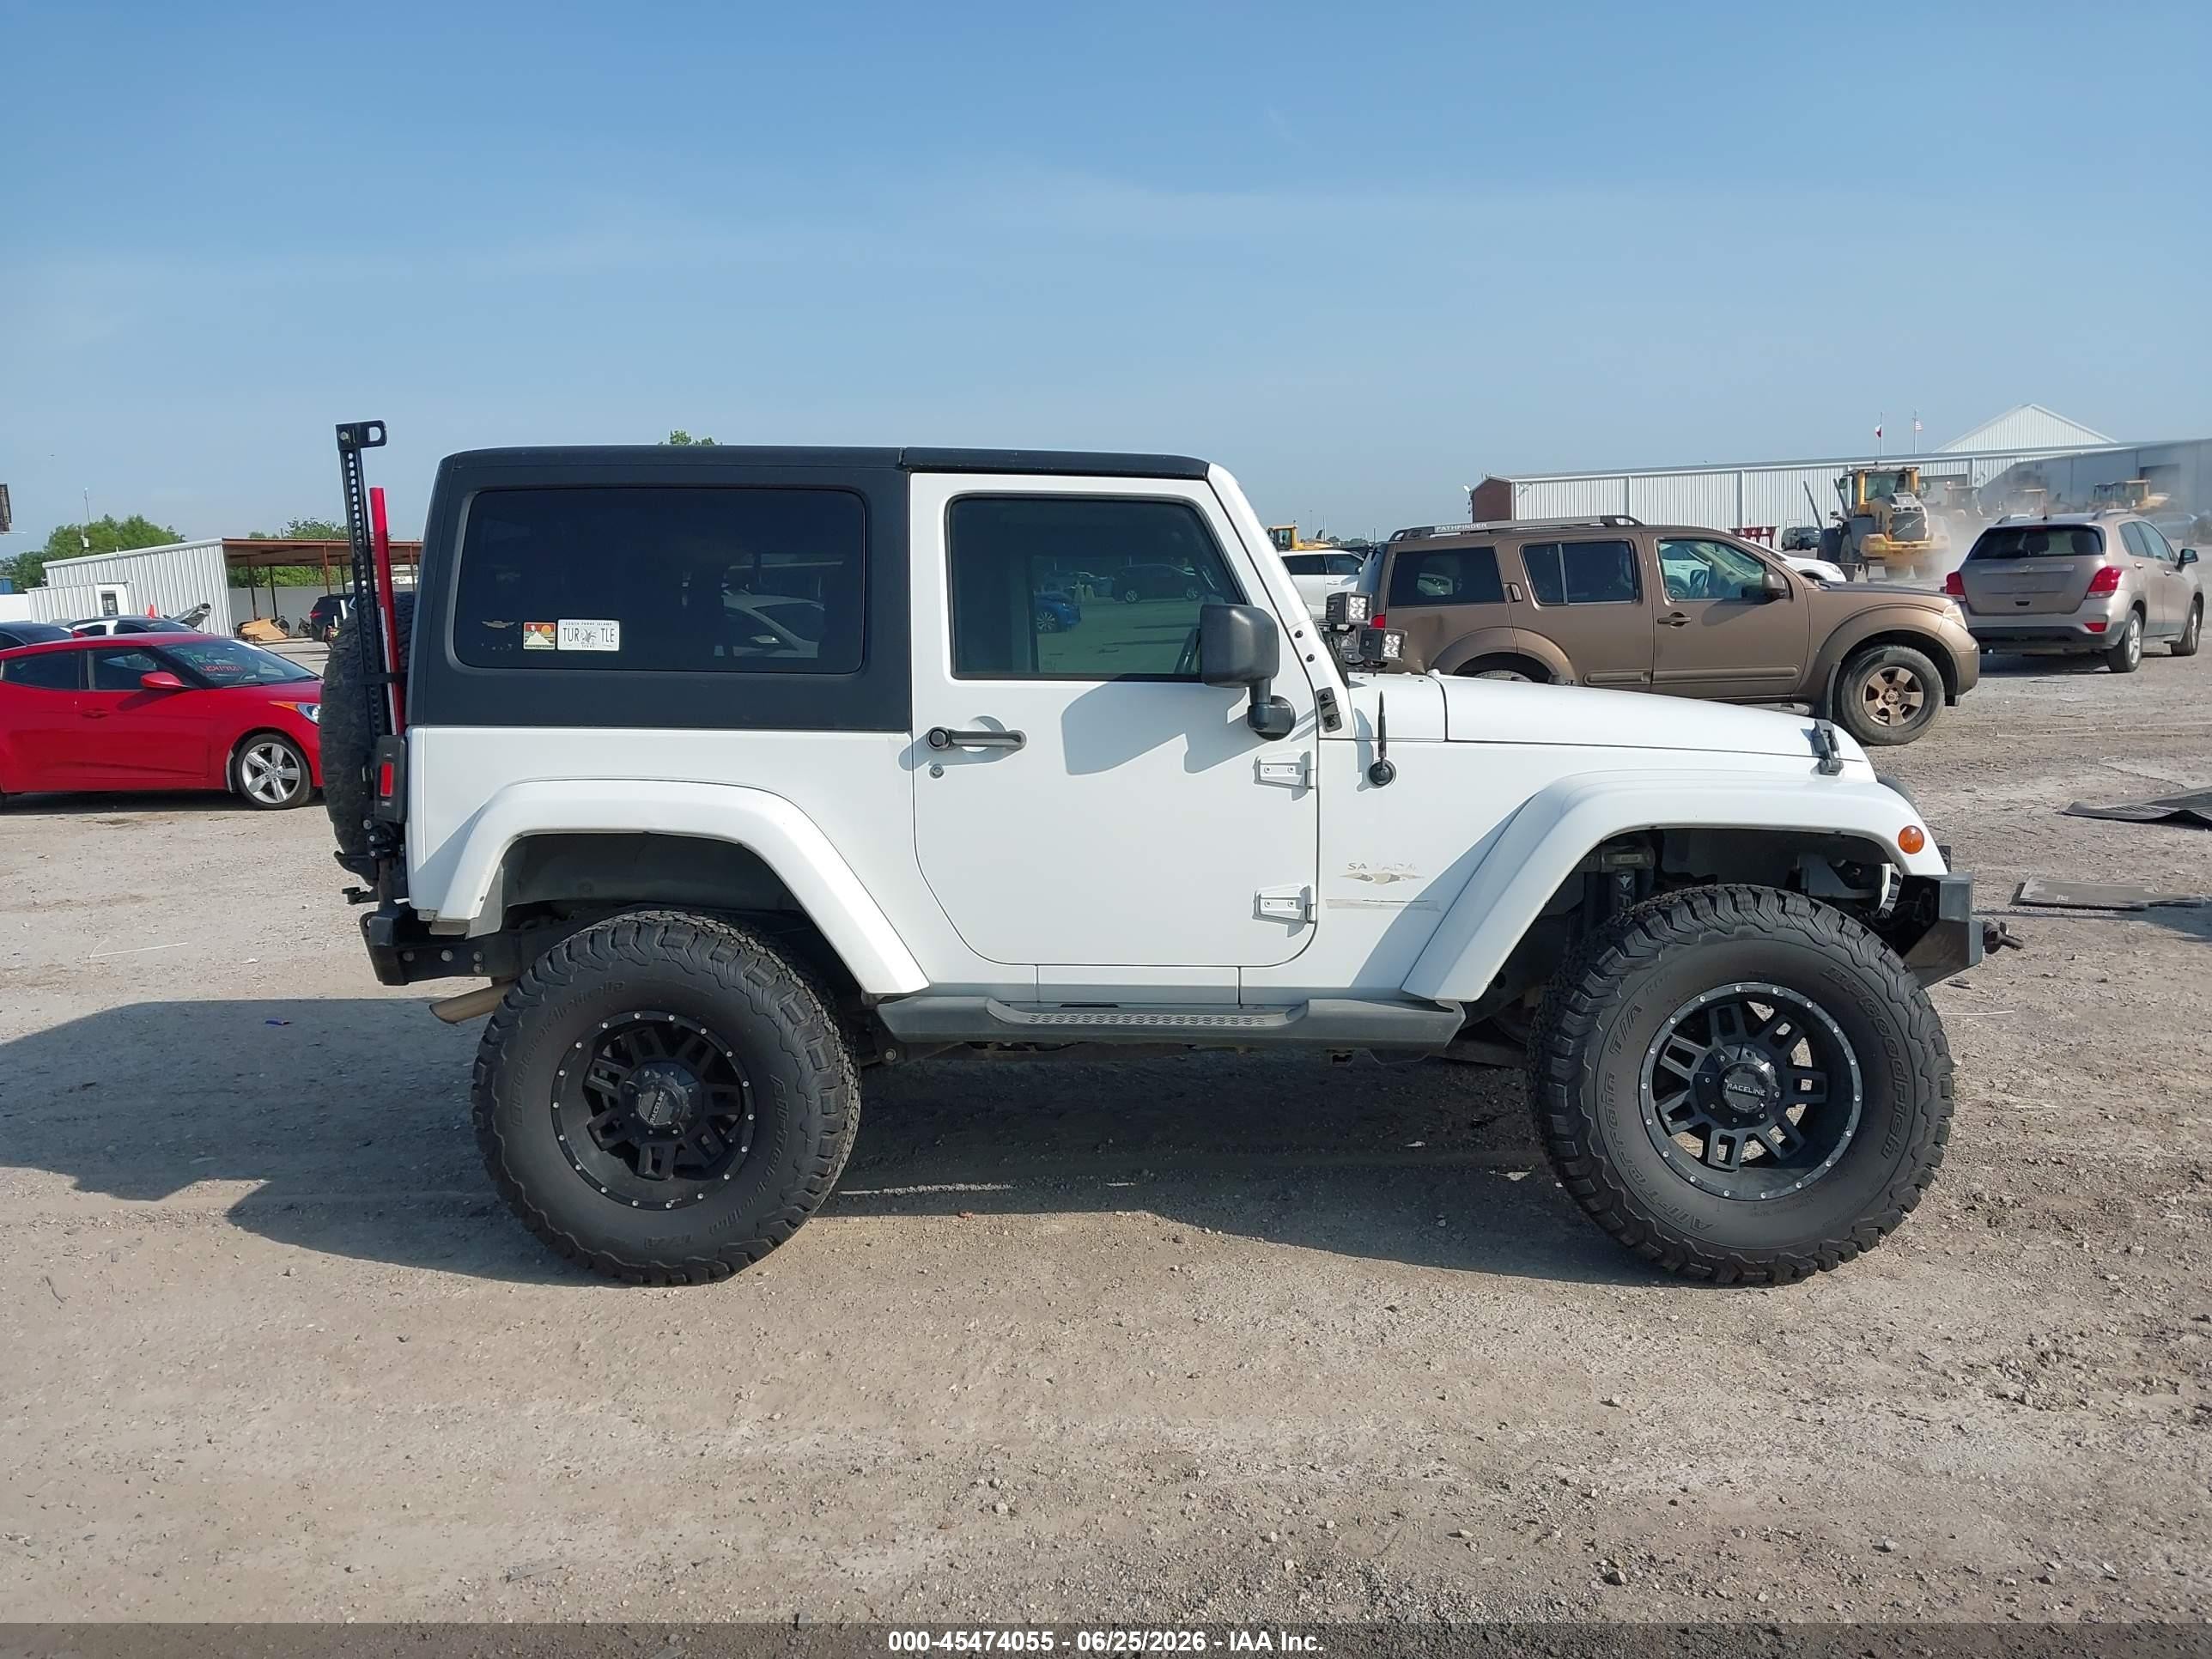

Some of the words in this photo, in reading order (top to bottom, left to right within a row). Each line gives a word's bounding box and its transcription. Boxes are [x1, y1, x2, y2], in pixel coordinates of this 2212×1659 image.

[1437, 523, 1486, 532] PATHFINDER
[563, 627, 580, 642] TUR
[601, 628, 615, 642] TLE
[1608, 1002, 1643, 1055] T/A
[1820, 964, 1909, 1159] BFGoodrich
[1727, 1083, 1766, 1097] RACELINE
[650, 1088, 665, 1124] RACELINE
